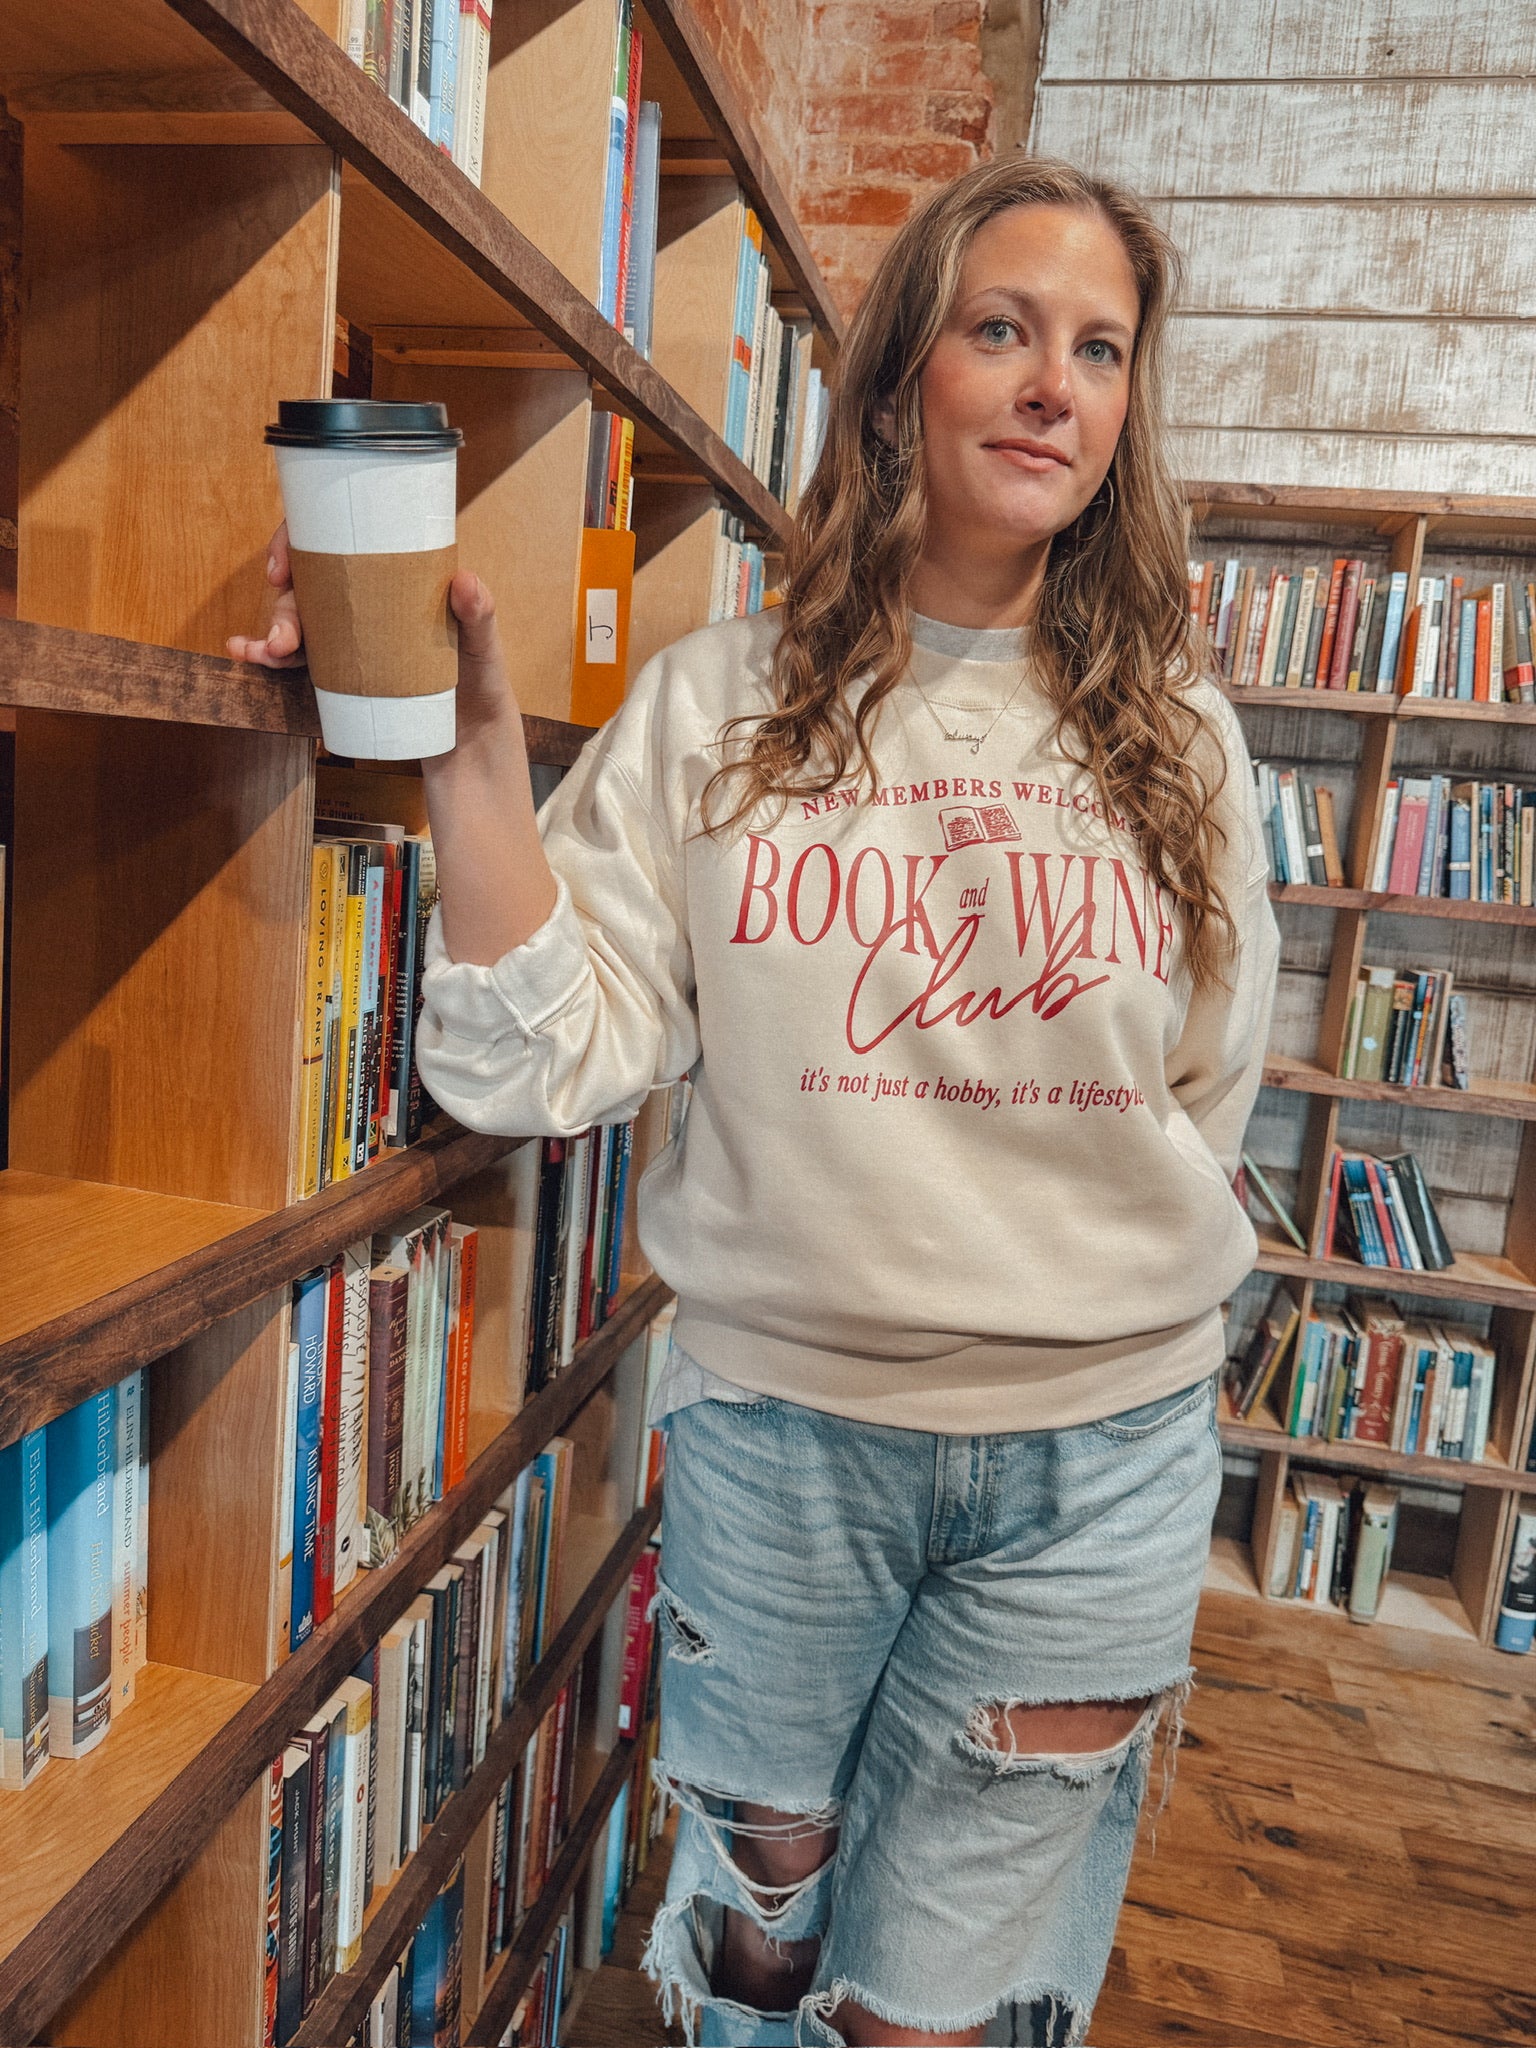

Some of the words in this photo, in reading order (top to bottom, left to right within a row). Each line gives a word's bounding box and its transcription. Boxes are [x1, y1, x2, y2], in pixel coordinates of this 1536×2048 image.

[447, 17, 455, 63] HOTEL
[441, 70, 449, 114] HOGAN
[447, 83, 455, 115] RUTH
[801, 788, 860, 820] NEW
[871, 778, 1003, 807] MEMBERS
[373, 880, 379, 891] A
[318, 889, 327, 968] LOVING
[370, 897, 378, 937] LONG
[730, 834, 949, 959] BOOK
[959, 878, 990, 909] and
[1004, 851, 1178, 986] WINE
[351, 950, 361, 1017] HORNBY
[846, 900, 1110, 1055] Club
[314, 981, 323, 1047] FRANK
[356, 1060, 366, 1128] HORNBY
[800, 1068, 829, 1093] it's
[837, 1073, 870, 1096] not
[872, 1071, 909, 1101] just
[914, 1081, 930, 1098] a
[934, 1079, 1001, 1109] hobby,
[1011, 1080, 1040, 1106] it's
[1047, 1087, 1062, 1105] a
[356, 1263, 371, 1352] ABSOLUTE
[303, 1334, 317, 1405] HOWARD
[461, 1362, 468, 1378] OF
[462, 1332, 470, 1361] YEAR
[126, 1404, 135, 1440] ELIN
[459, 1380, 467, 1417] LIVING
[97, 1391, 110, 1518] Hilderbrand
[458, 1419, 466, 1454] SIMPLY
[29, 1447, 40, 1495] Elin
[305, 1446, 318, 1515] KILLING
[124, 1443, 134, 1549] HILDERBRAND
[29, 1496, 42, 1619] Hilderbrand
[90, 1541, 104, 1582] Hotel
[303, 1516, 317, 1563] TIME
[122, 1560, 131, 1616] summer
[89, 1582, 103, 1660] Nantucket
[119, 1618, 133, 1665] people
[37, 1659, 45, 1683] The
[28, 1665, 38, 1729] Nantucket
